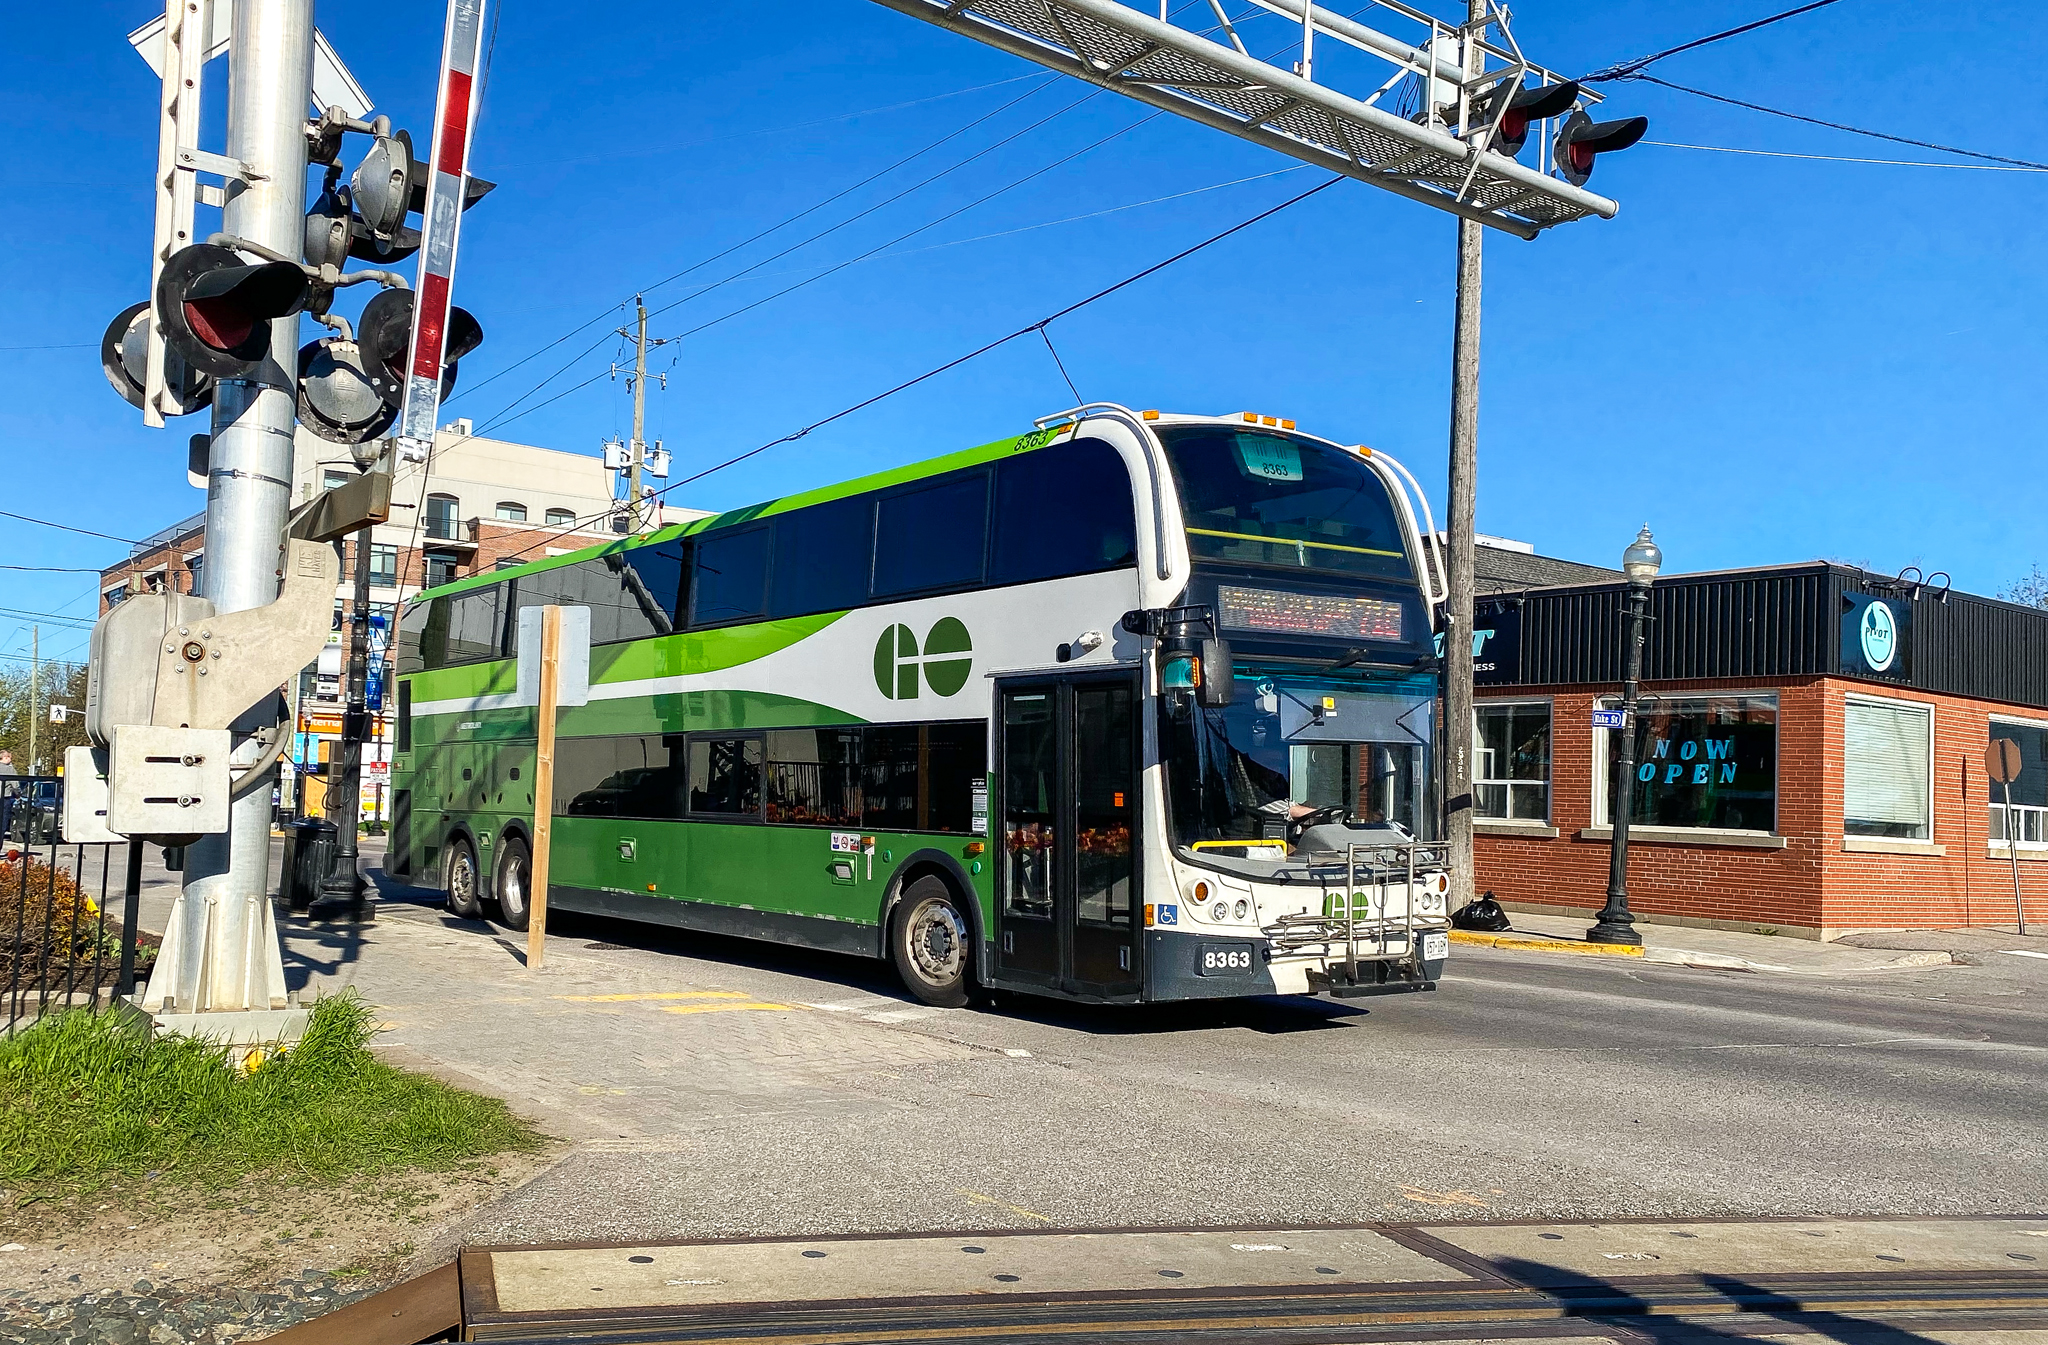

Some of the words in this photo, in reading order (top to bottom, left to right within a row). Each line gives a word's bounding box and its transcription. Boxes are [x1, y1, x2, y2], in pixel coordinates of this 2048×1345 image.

[1014, 431, 1049, 451] 8363
[1262, 462, 1289, 477] 8363
[873, 616, 973, 701] GO
[1610, 715, 1619, 724] St
[1652, 738, 1731, 761] NOW
[1638, 762, 1738, 785] OPEN
[1205, 951, 1251, 968] 8363
